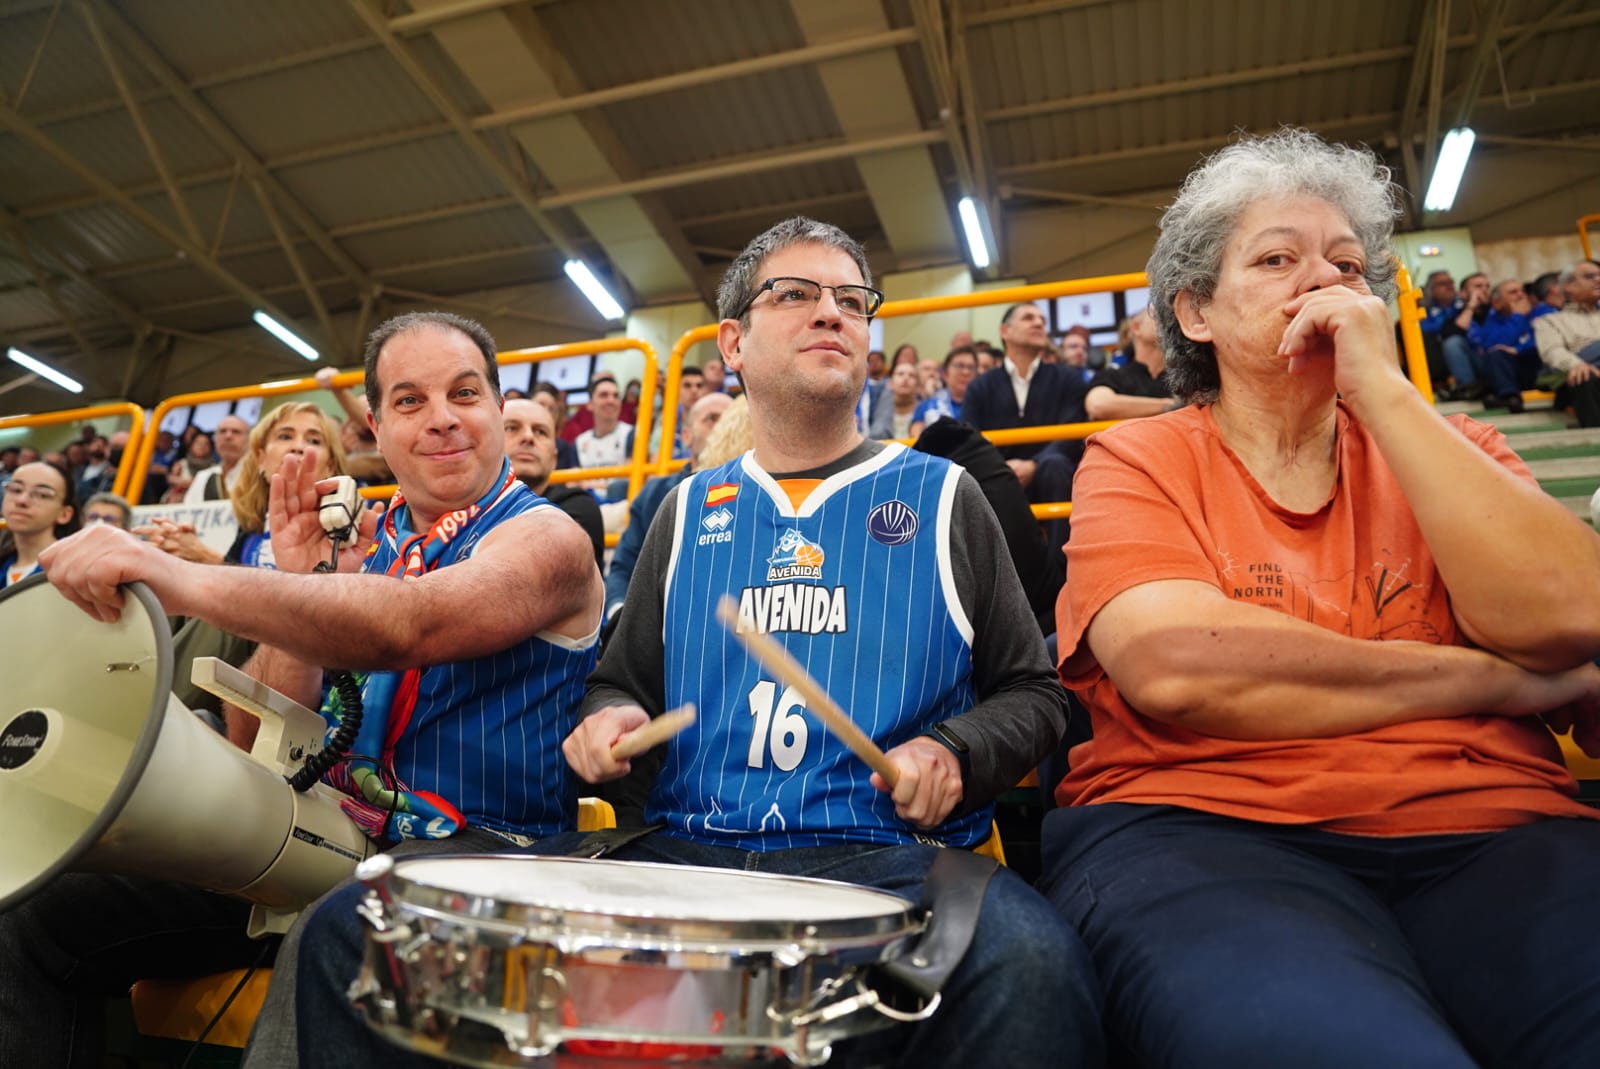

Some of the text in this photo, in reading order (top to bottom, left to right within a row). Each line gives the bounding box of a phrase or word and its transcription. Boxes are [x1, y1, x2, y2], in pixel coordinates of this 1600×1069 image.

[698, 530, 732, 546] errea
[769, 565, 821, 580] AVENIDA
[1256, 575, 1284, 585] THE
[1233, 586, 1283, 599] NORTH
[735, 582, 848, 635] AVENIDA
[747, 679, 809, 772] 16
